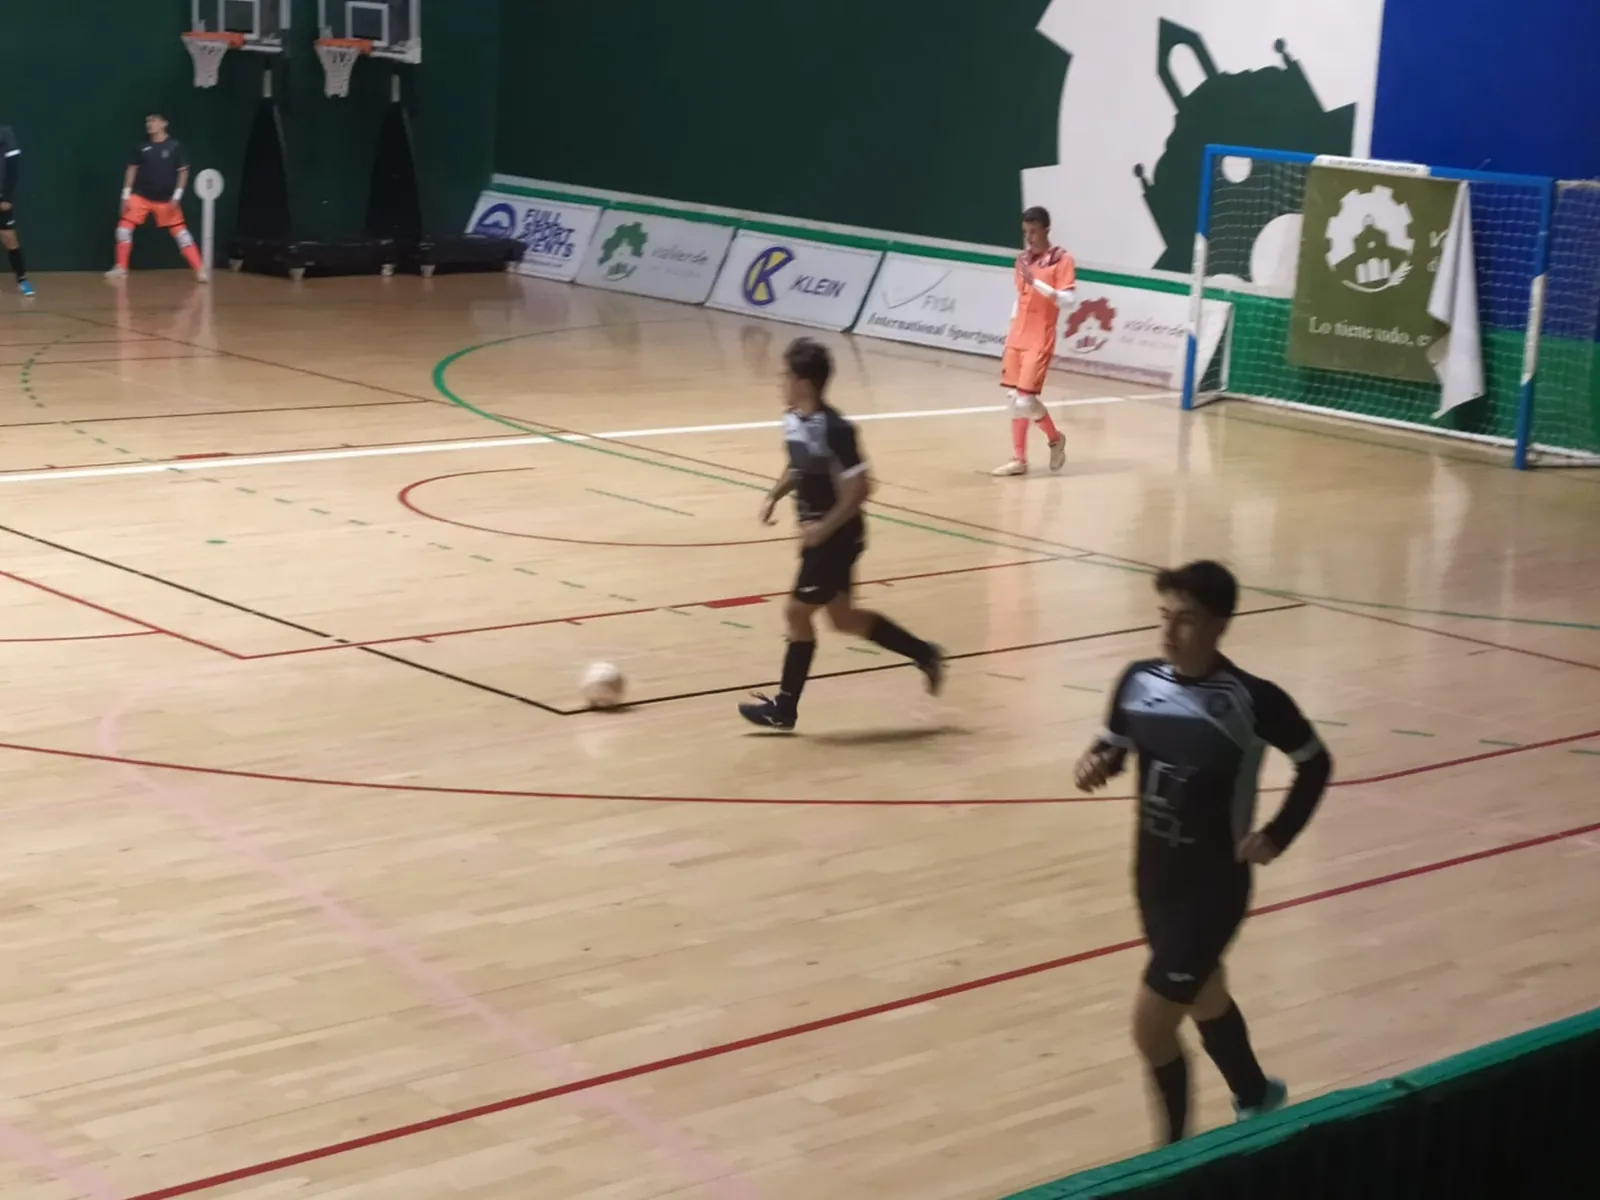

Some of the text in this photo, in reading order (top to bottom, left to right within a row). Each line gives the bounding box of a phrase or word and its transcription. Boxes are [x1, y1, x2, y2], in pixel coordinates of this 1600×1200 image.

[524, 238, 575, 258] VENTS
[790, 274, 846, 299] KLEIN
[867, 312, 948, 337] International
[1308, 316, 1332, 335] Lo
